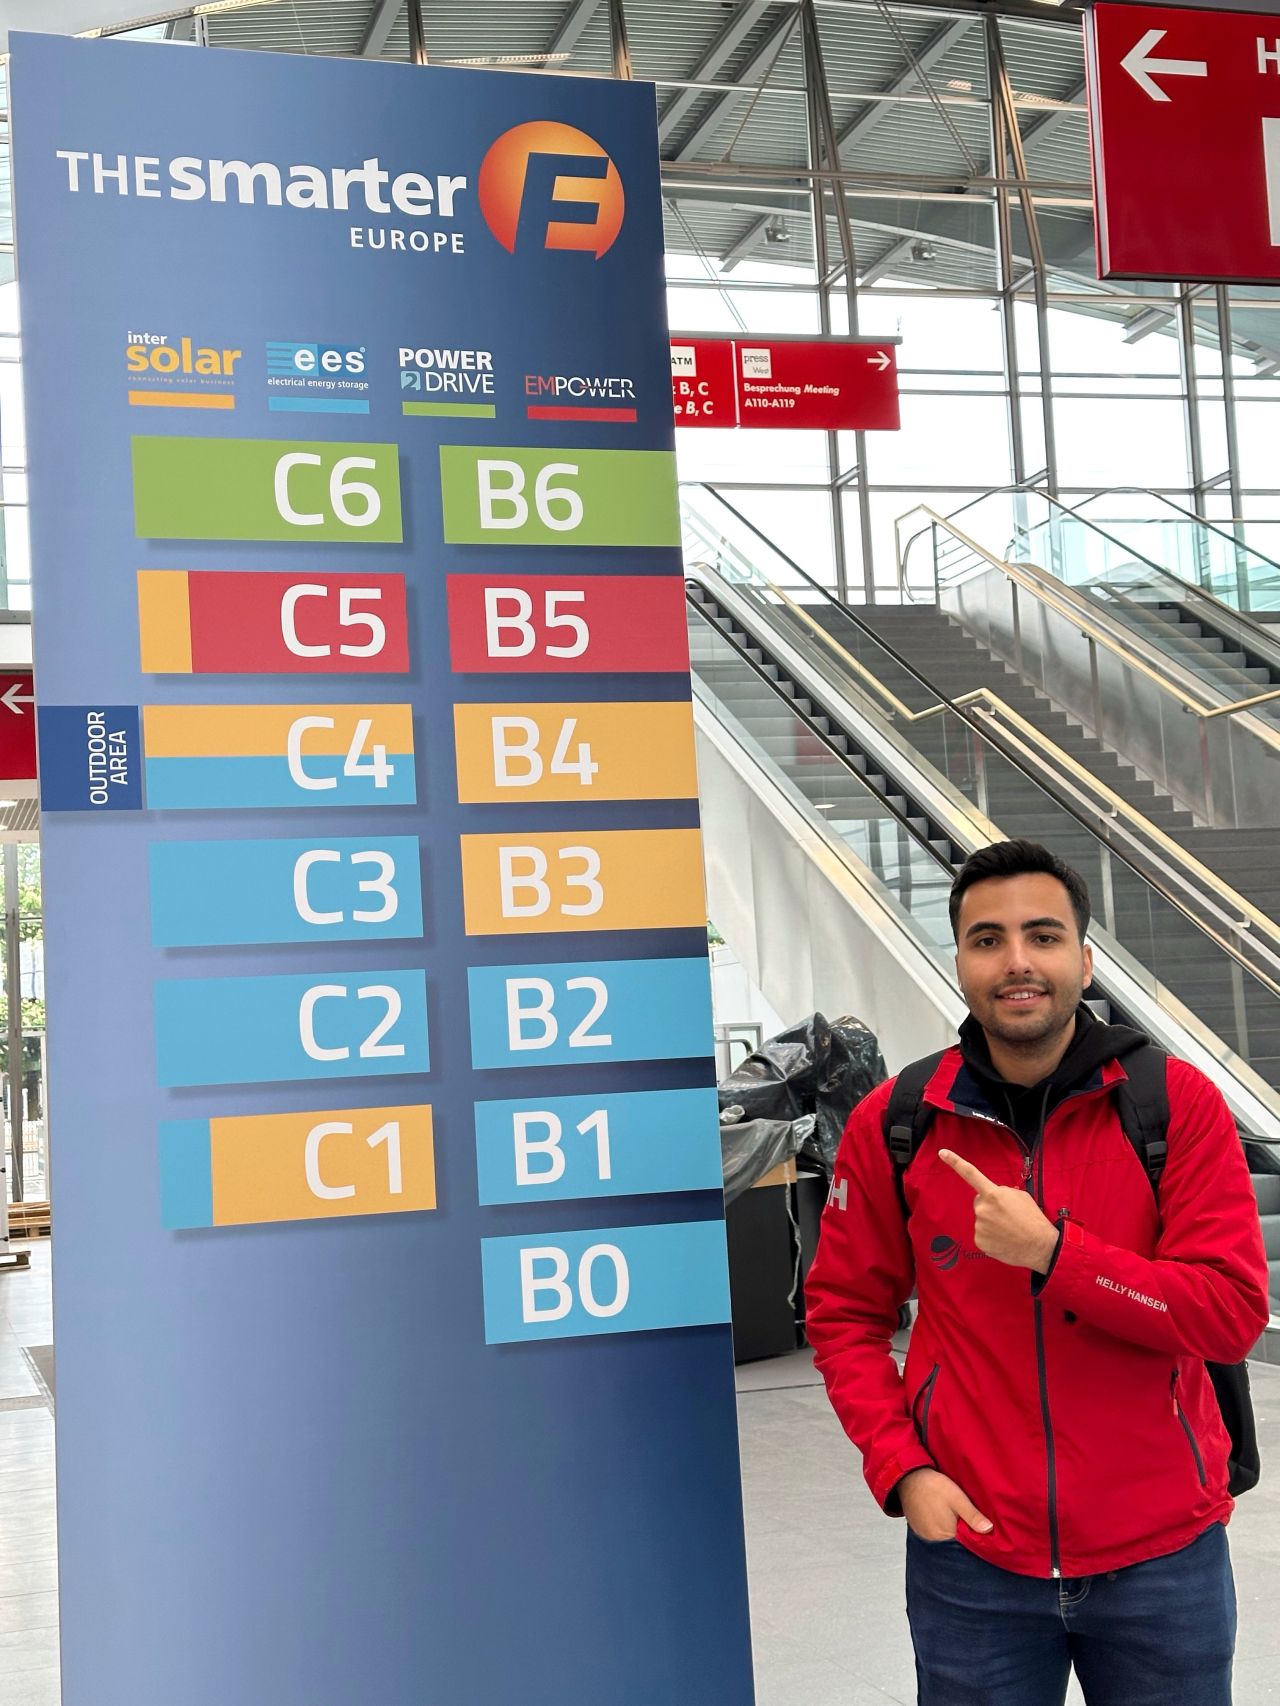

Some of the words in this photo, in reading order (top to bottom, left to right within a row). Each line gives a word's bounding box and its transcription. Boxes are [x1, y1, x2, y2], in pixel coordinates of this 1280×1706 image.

[350, 227, 465, 254] EUROPE
[126, 336, 242, 375] solar
[127, 331, 168, 345] inter
[399, 348, 493, 370] POWER
[671, 357, 693, 365] ATM
[743, 355, 769, 364] press
[267, 377, 306, 387] electrical
[307, 380, 336, 390] energy
[337, 380, 369, 390] storage
[425, 371, 495, 394] DRIVE
[525, 375, 636, 398] EMPOWER
[680, 381, 695, 398] B,
[698, 381, 709, 396] C
[685, 400, 700, 417] B,
[702, 400, 714, 415] C
[743, 382, 801, 395] Besprechung
[803, 384, 840, 396] Meeting
[744, 398, 795, 408] A110-A119
[274, 452, 381, 527] C6
[476, 459, 584, 531] B6
[280, 583, 386, 658] C5
[484, 587, 590, 659] B5
[87, 711, 109, 805] OUTDOOR
[108, 730, 128, 785] AREA
[287, 715, 395, 791] C4
[491, 715, 599, 787] B4
[293, 849, 399, 925] C3
[499, 846, 605, 919] B3
[299, 984, 406, 1062] C2
[505, 976, 613, 1052] B2
[304, 1122, 403, 1200] C1
[512, 1109, 612, 1187] B1
[519, 1243, 631, 1324] B0
[1095, 1274, 1128, 1295] HELLY
[1127, 1288, 1168, 1313] HANSEN
